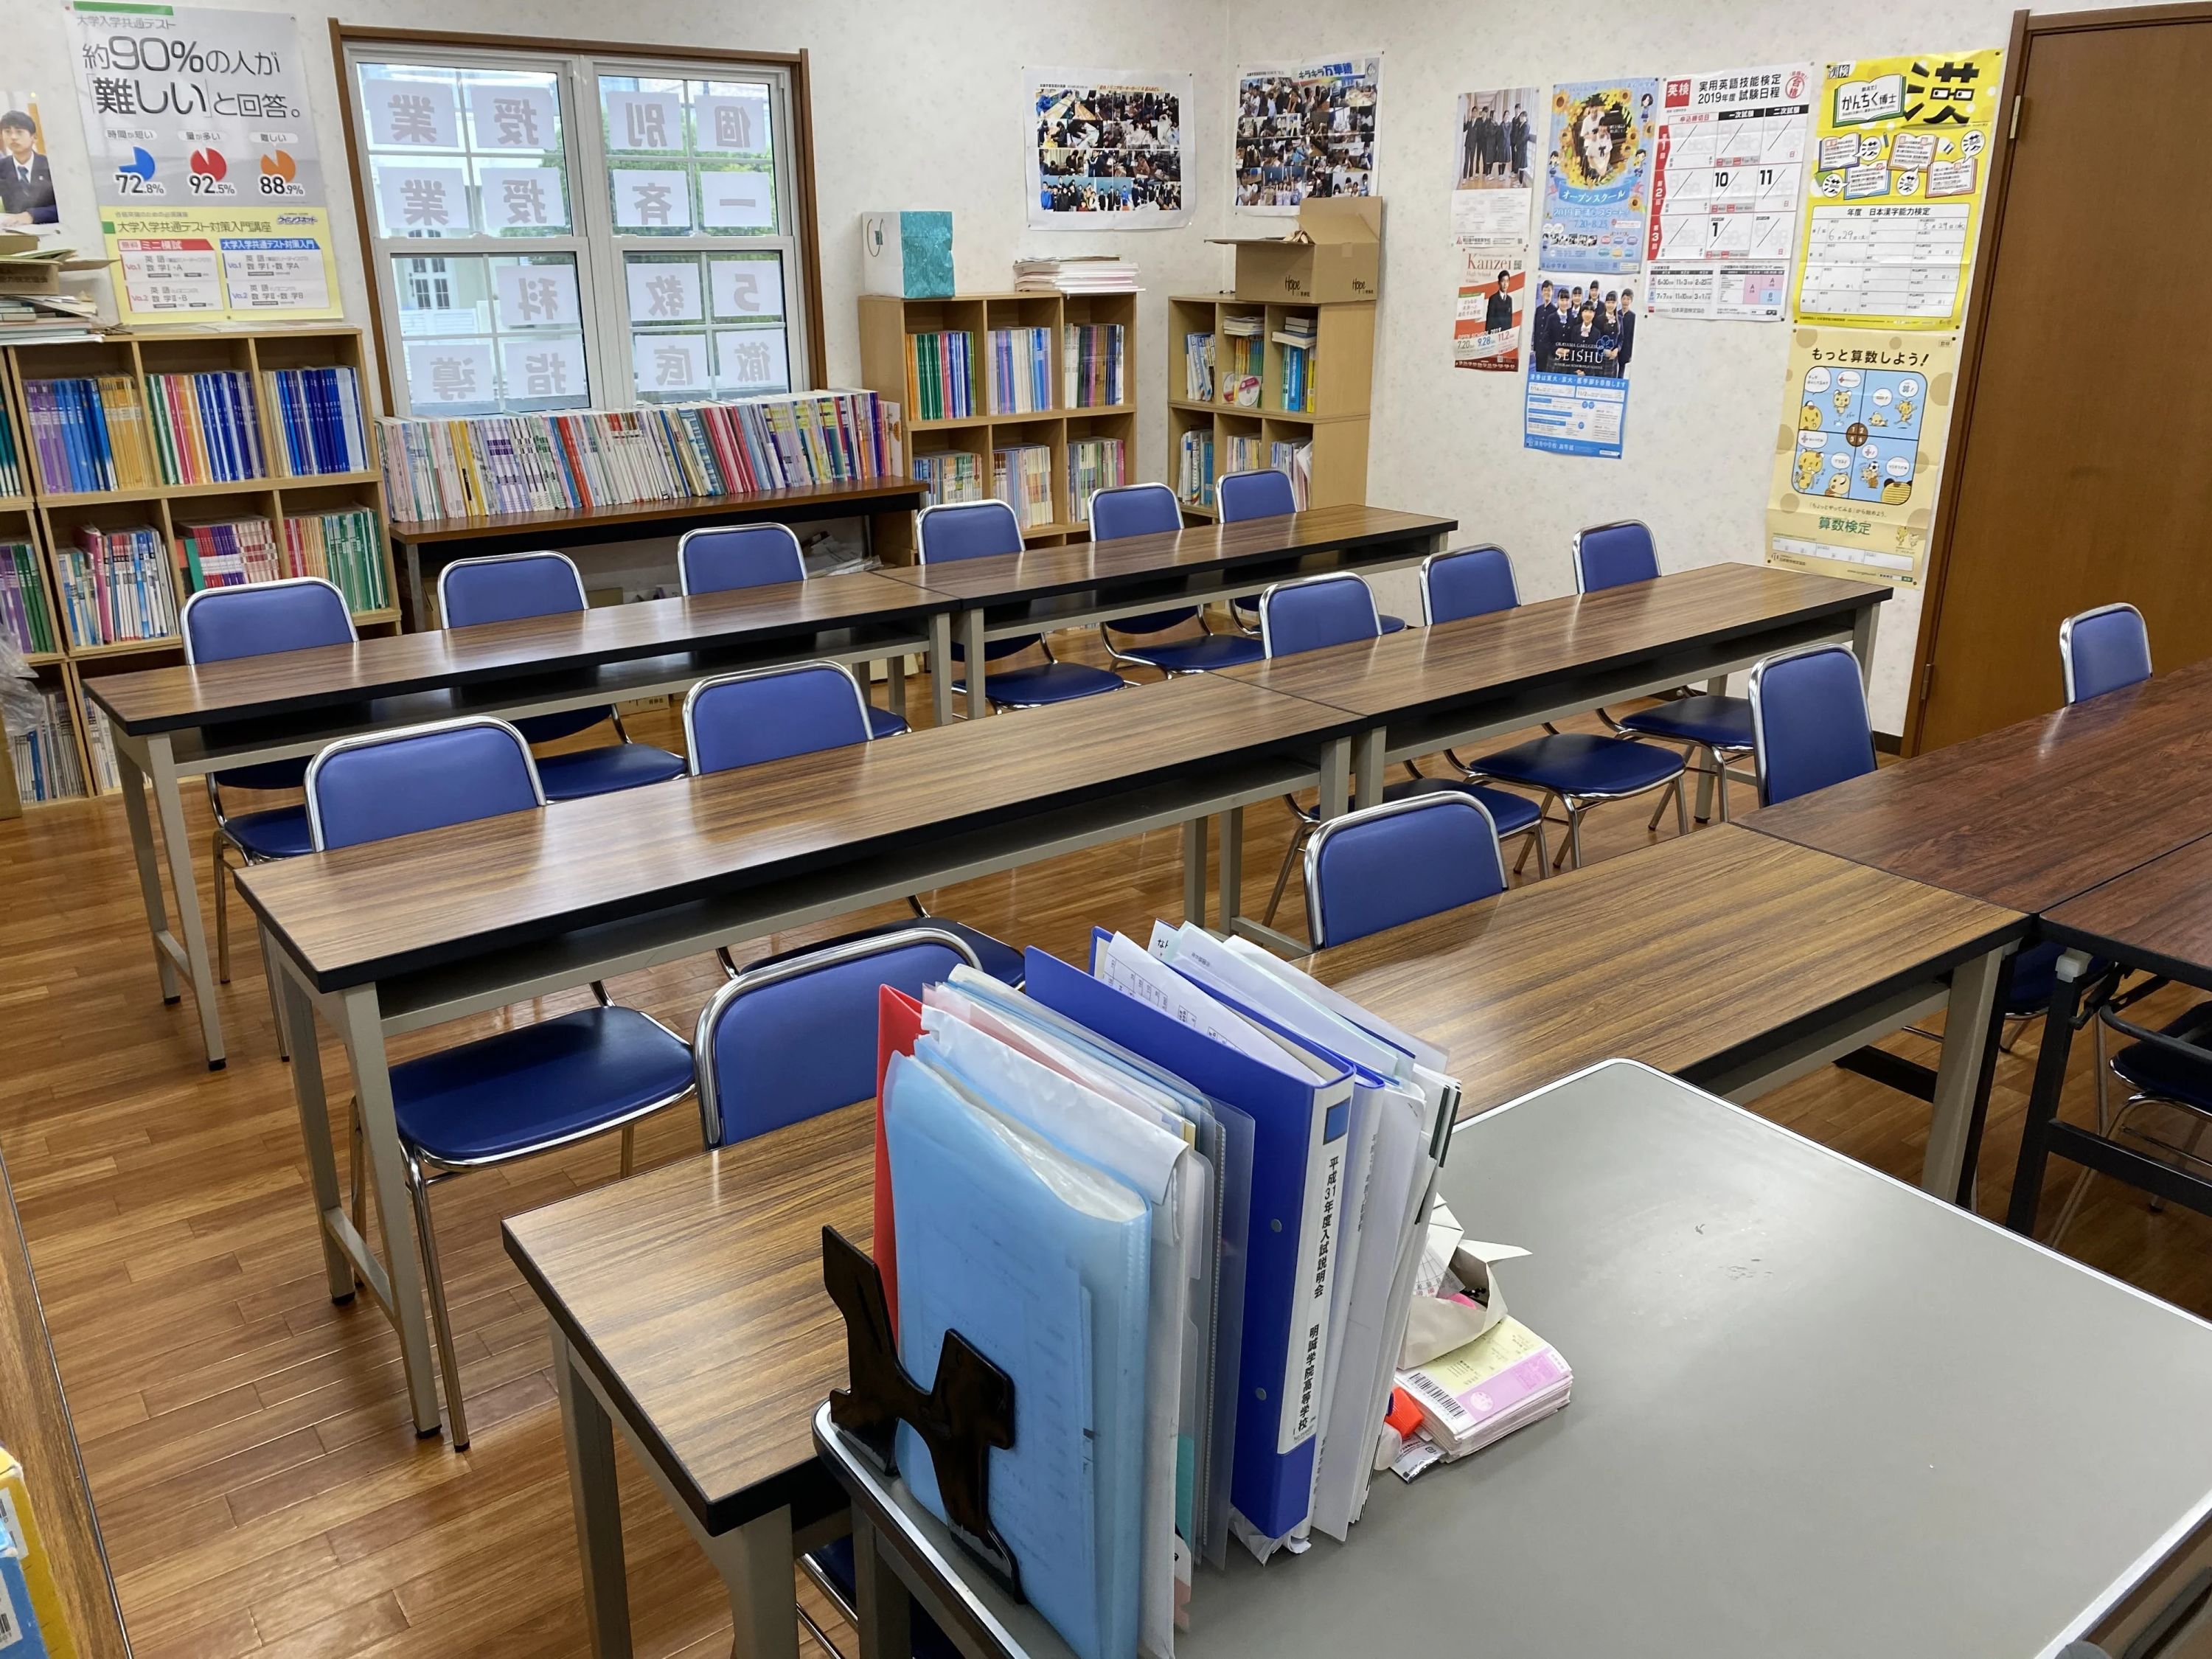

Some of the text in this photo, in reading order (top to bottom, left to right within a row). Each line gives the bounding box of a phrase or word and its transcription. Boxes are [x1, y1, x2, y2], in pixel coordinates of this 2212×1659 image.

[77, 15, 176, 29] 大学入学共通テスト
[83, 35, 281, 75] 約90%の人が
[1299, 62, 1352, 80] キラキラ万華鏡
[1668, 83, 1690, 97] 英検
[1699, 74, 1781, 92] 実用英語技能検定
[86, 74, 300, 118] 「難しい」と回答。
[1698, 86, 1780, 104] 2019年度 試験日程
[1842, 91, 1897, 111] かんちく博士
[1728, 110, 1755, 119] 一次試験
[1773, 106, 1801, 115] 二次試験
[107, 130, 153, 139] 時間が短い
[186, 131, 220, 141] 量が多い
[260, 133, 287, 142] 難しい
[115, 174, 164, 194] 72.8%
[189, 175, 235, 194] 92.5%
[260, 176, 304, 195] 88.9%
[1714, 171, 1729, 187] 10
[1760, 169, 1773, 186] 11
[1562, 189, 1625, 203] オープンスクール
[1847, 207, 1930, 216] 年度 日本漢字能力検定
[118, 222, 272, 233] 大学入学共通テスト対策入門講座
[1468, 253, 1512, 271] Kanzei
[1285, 274, 1301, 296] Hope
[1352, 277, 1366, 294] Hope
[1478, 336, 1491, 347] 9.28
[1498, 331, 1509, 342] 11.2
[1554, 349, 1604, 364] SEISHU
[1812, 348, 1929, 366] もっと算数しよう！
[1818, 517, 1871, 535] 算数検定
[1314, 1155, 1340, 1299] 平成31年度入試説明会
[1298, 1323, 1320, 1432] 明誠学院高等学校
